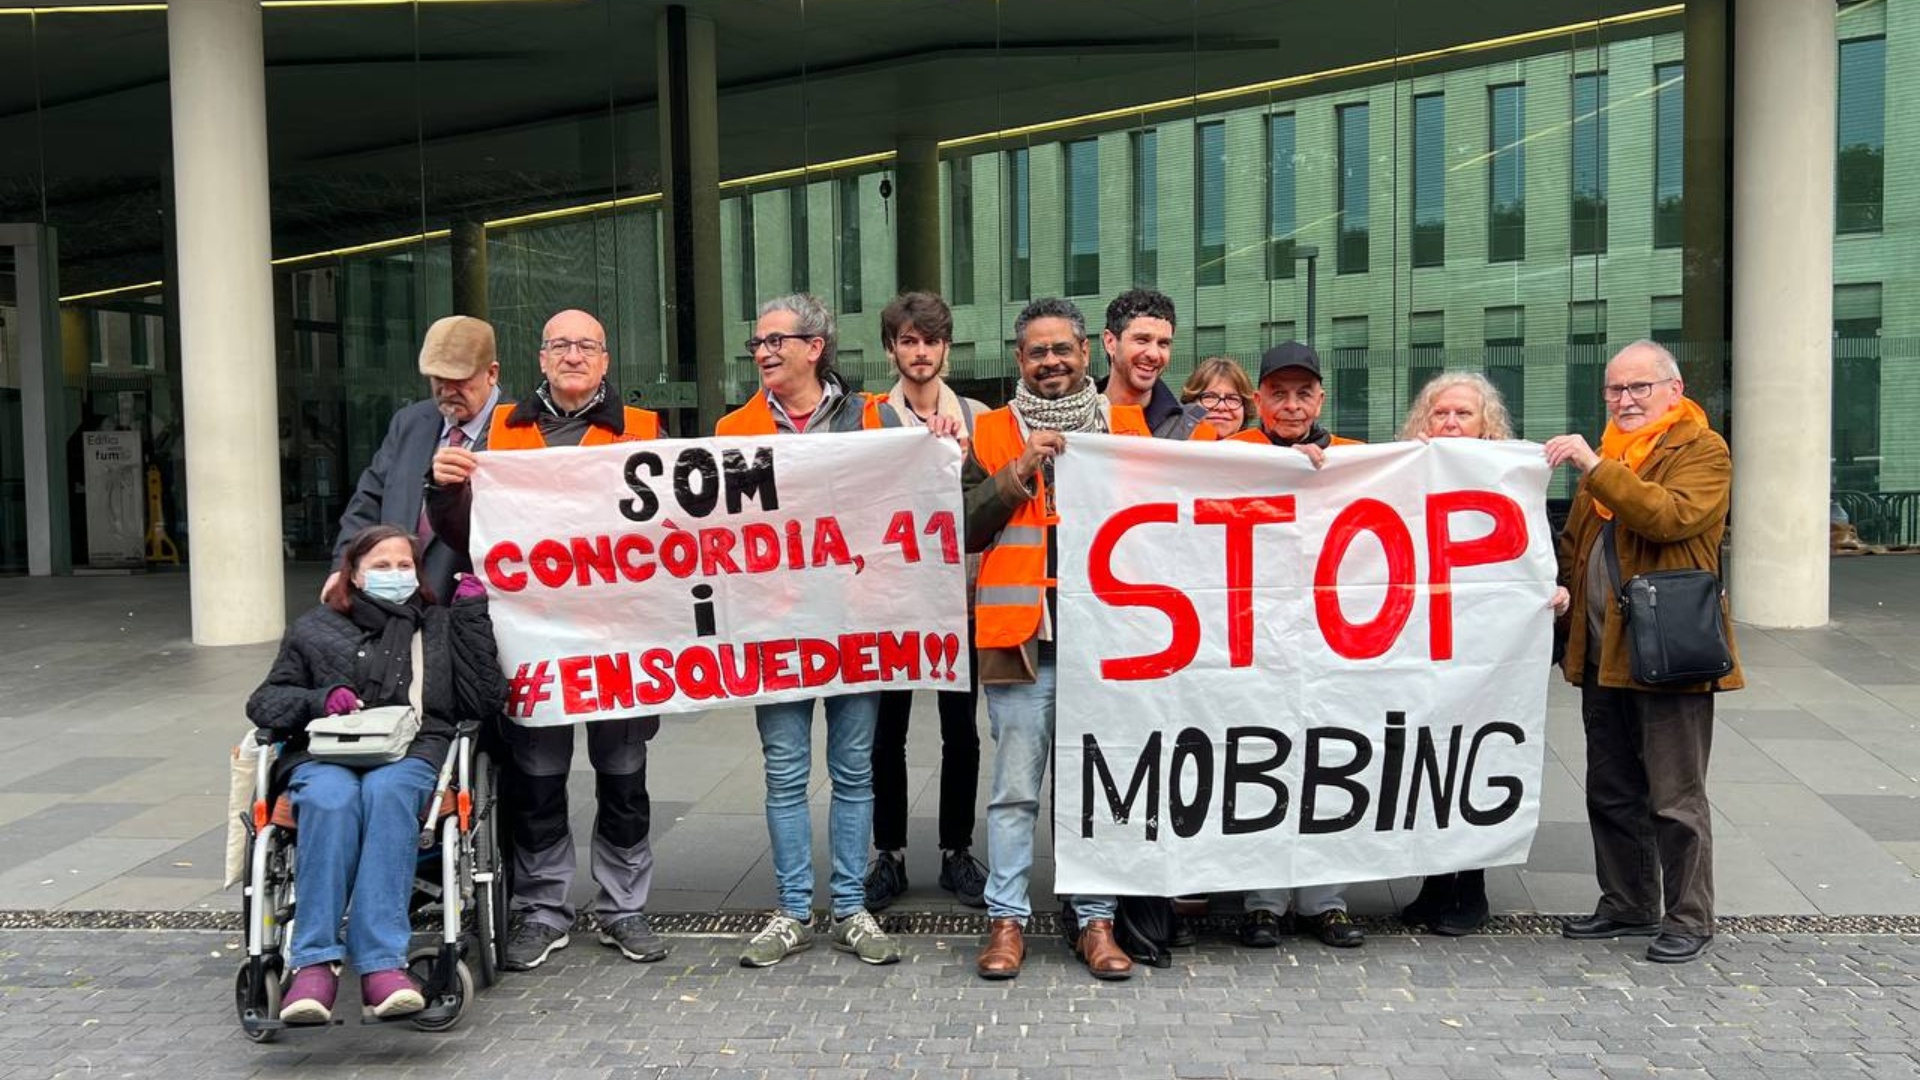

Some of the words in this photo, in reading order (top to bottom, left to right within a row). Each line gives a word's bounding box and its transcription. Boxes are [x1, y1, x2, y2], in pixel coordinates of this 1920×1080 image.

[618, 447, 780, 522] SOM
[881, 510, 961, 565] 41
[1088, 490, 1529, 681] STOP
[506, 631, 960, 718] #ENSQUEDEM!!
